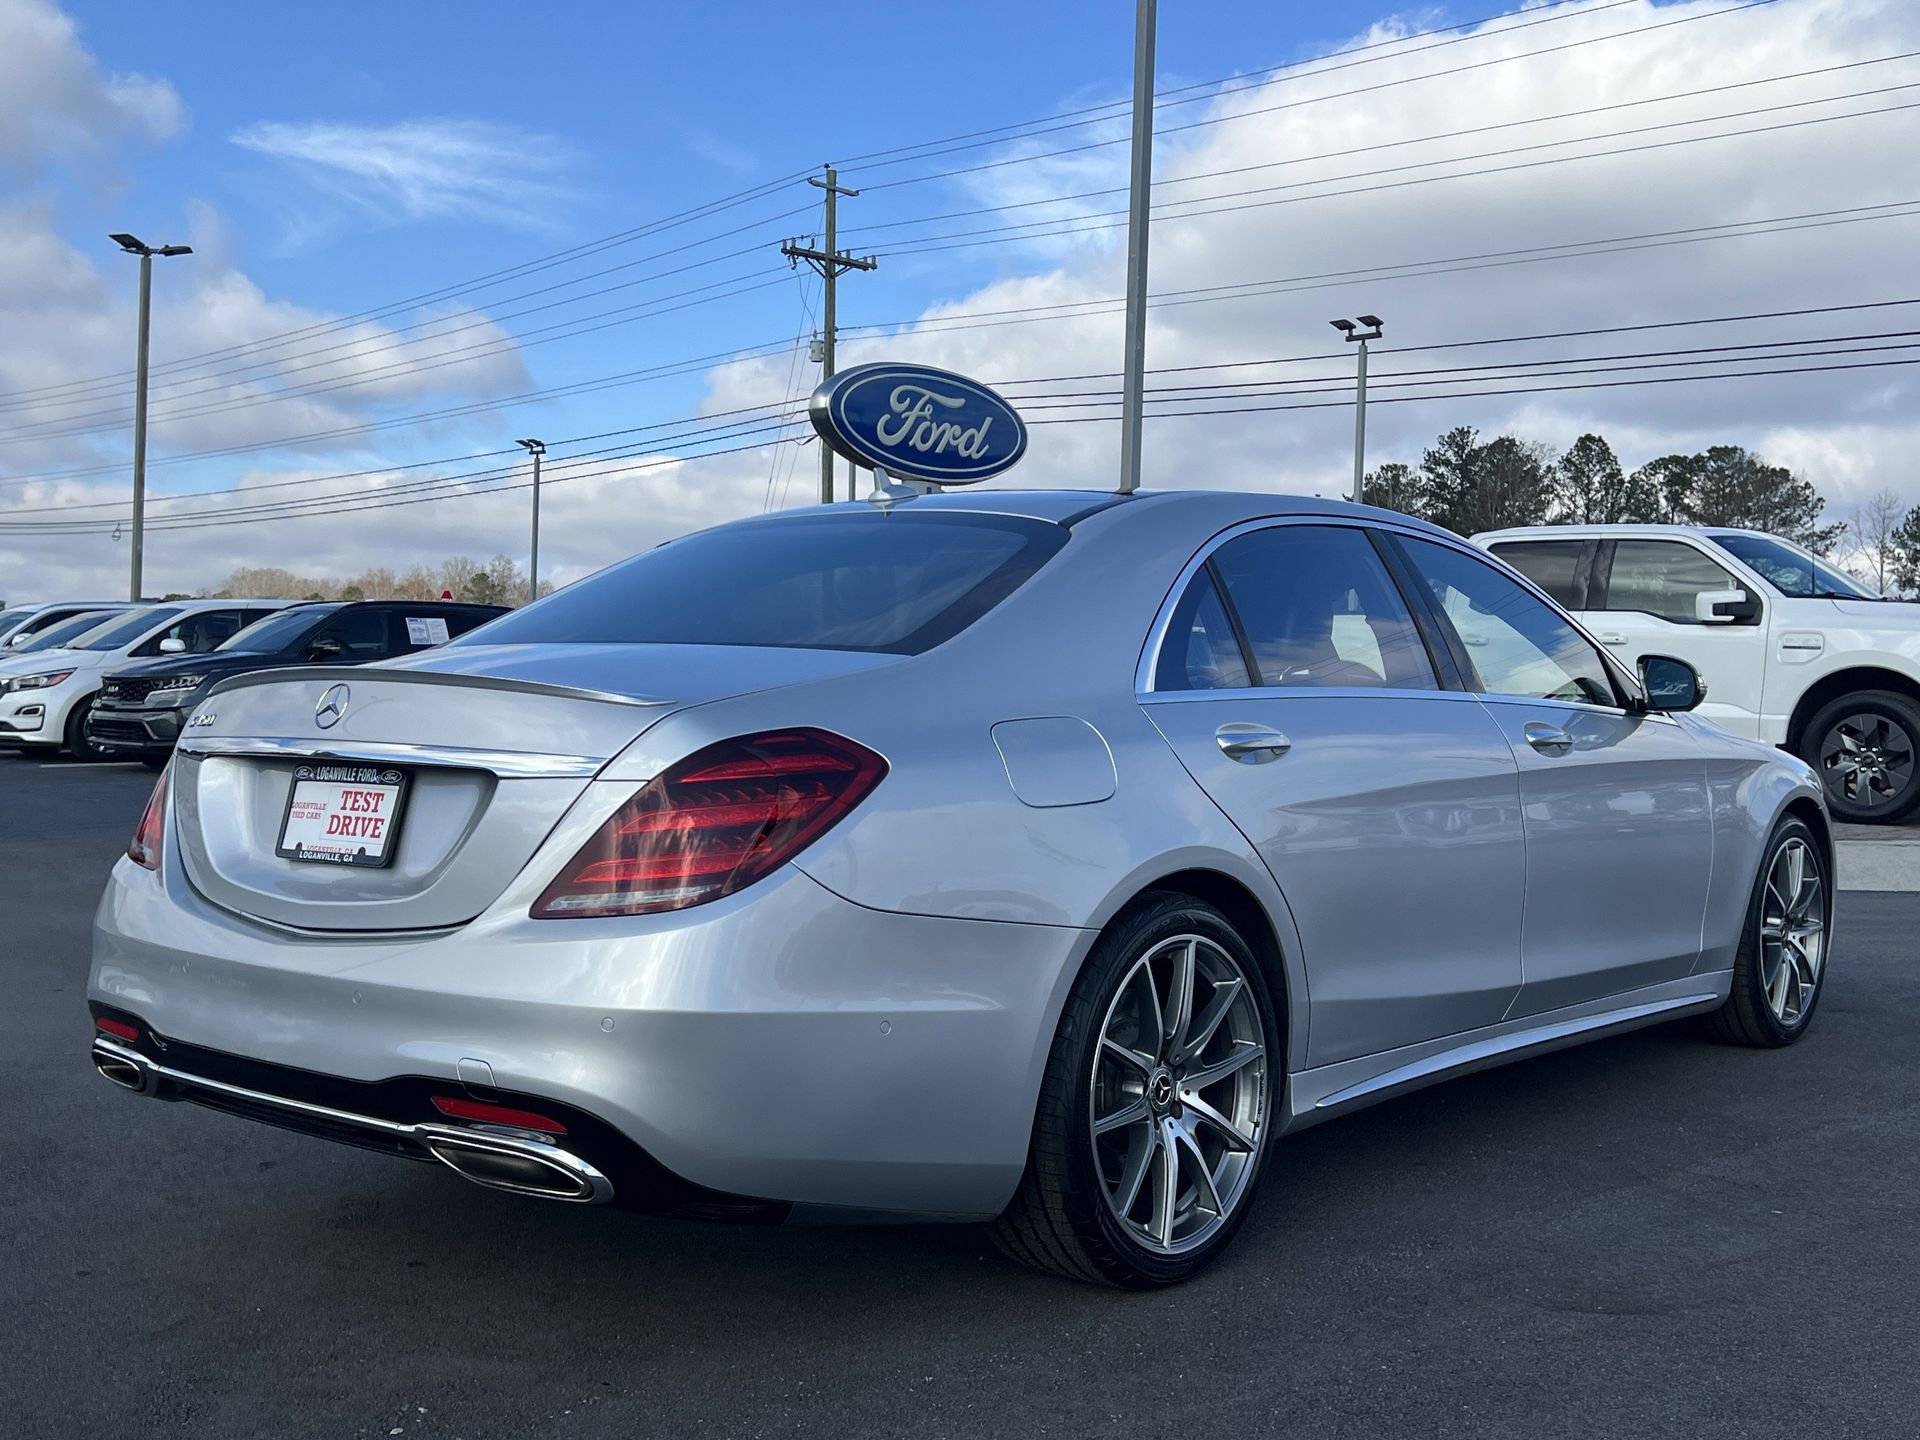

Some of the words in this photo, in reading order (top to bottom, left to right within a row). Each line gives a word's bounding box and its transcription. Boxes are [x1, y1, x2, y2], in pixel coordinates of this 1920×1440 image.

[876, 384, 993, 460] Ford
[316, 766, 357, 780] LOGANVILLE
[357, 768, 377, 783] FORD
[291, 801, 327, 811] LOGANVILLE
[340, 790, 385, 813] TEST
[292, 811, 305, 819] USED
[306, 812, 321, 820] CARS
[326, 814, 385, 839] DRIVE
[299, 851, 341, 863] LOGANVILLE,
[343, 854, 353, 863] GA
